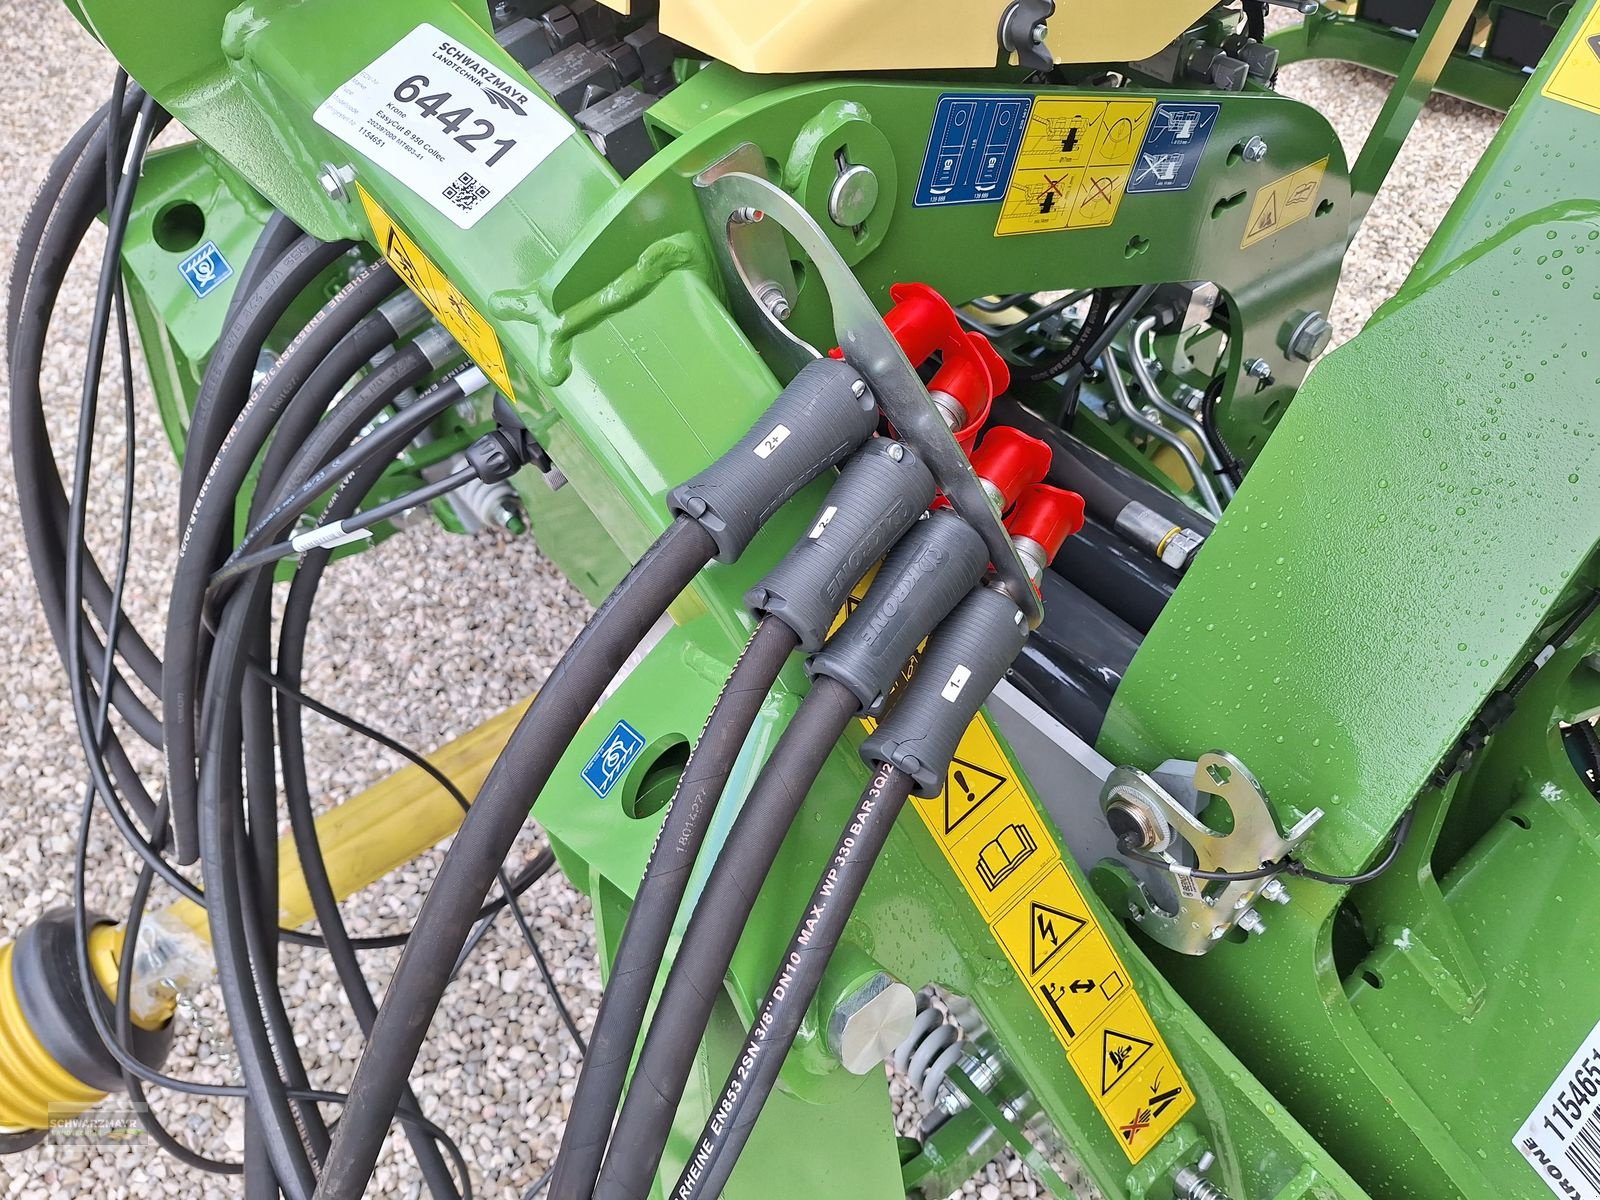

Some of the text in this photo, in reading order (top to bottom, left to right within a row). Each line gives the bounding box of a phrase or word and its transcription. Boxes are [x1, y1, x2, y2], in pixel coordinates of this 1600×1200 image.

[432, 51, 483, 87] LANDTECHNIK
[438, 42, 529, 105] SCHWARZMAYR
[386, 102, 407, 119] Krone
[394, 75, 518, 168] 64421
[358, 126, 386, 148] 1154651
[376, 110, 405, 133] EasyCut
[404, 129, 412, 137] B
[410, 134, 424, 146] 950
[423, 143, 446, 162] Collec
[328, 271, 370, 309] RHEINE
[294, 310, 326, 345] EN853
[275, 343, 295, 369] 2SN
[238, 391, 259, 423] DN10
[764, 436, 779, 451] 2+
[209, 456, 222, 477] WP
[818, 517, 830, 529] 2-
[861, 562, 923, 646] KRONE
[950, 679, 961, 689] 1-
[678, 1138, 715, 1197] RHEINE
[710, 1080, 743, 1137] EN853
[737, 1041, 761, 1081] 2SN
[772, 951, 802, 1001] DN10
[797, 902, 827, 946] MAX.
[819, 868, 838, 897] WP
[834, 837, 856, 867] 330
[849, 800, 876, 836] BAR
